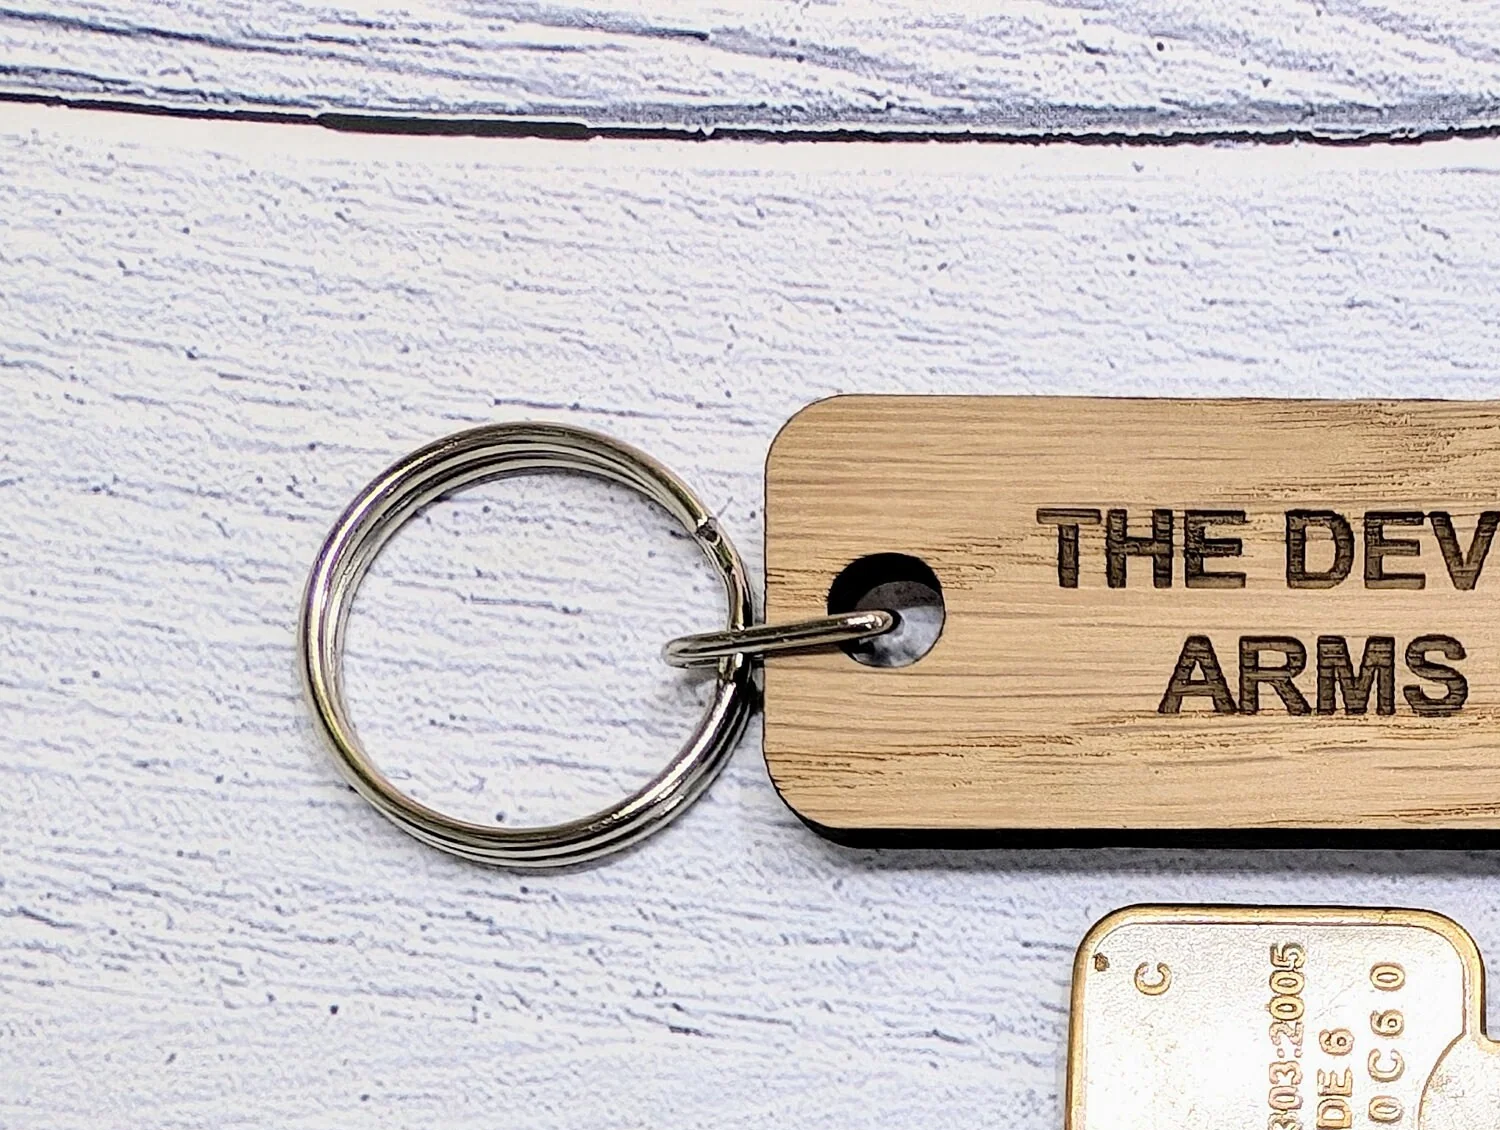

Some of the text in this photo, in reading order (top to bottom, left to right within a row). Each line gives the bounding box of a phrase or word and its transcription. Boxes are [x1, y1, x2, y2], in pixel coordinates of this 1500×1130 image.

[1037, 509, 1249, 588] THE
[1159, 635, 1468, 716] ARMS
[1135, 962, 1171, 995] C
[1320, 1028, 1354, 1055] 6
